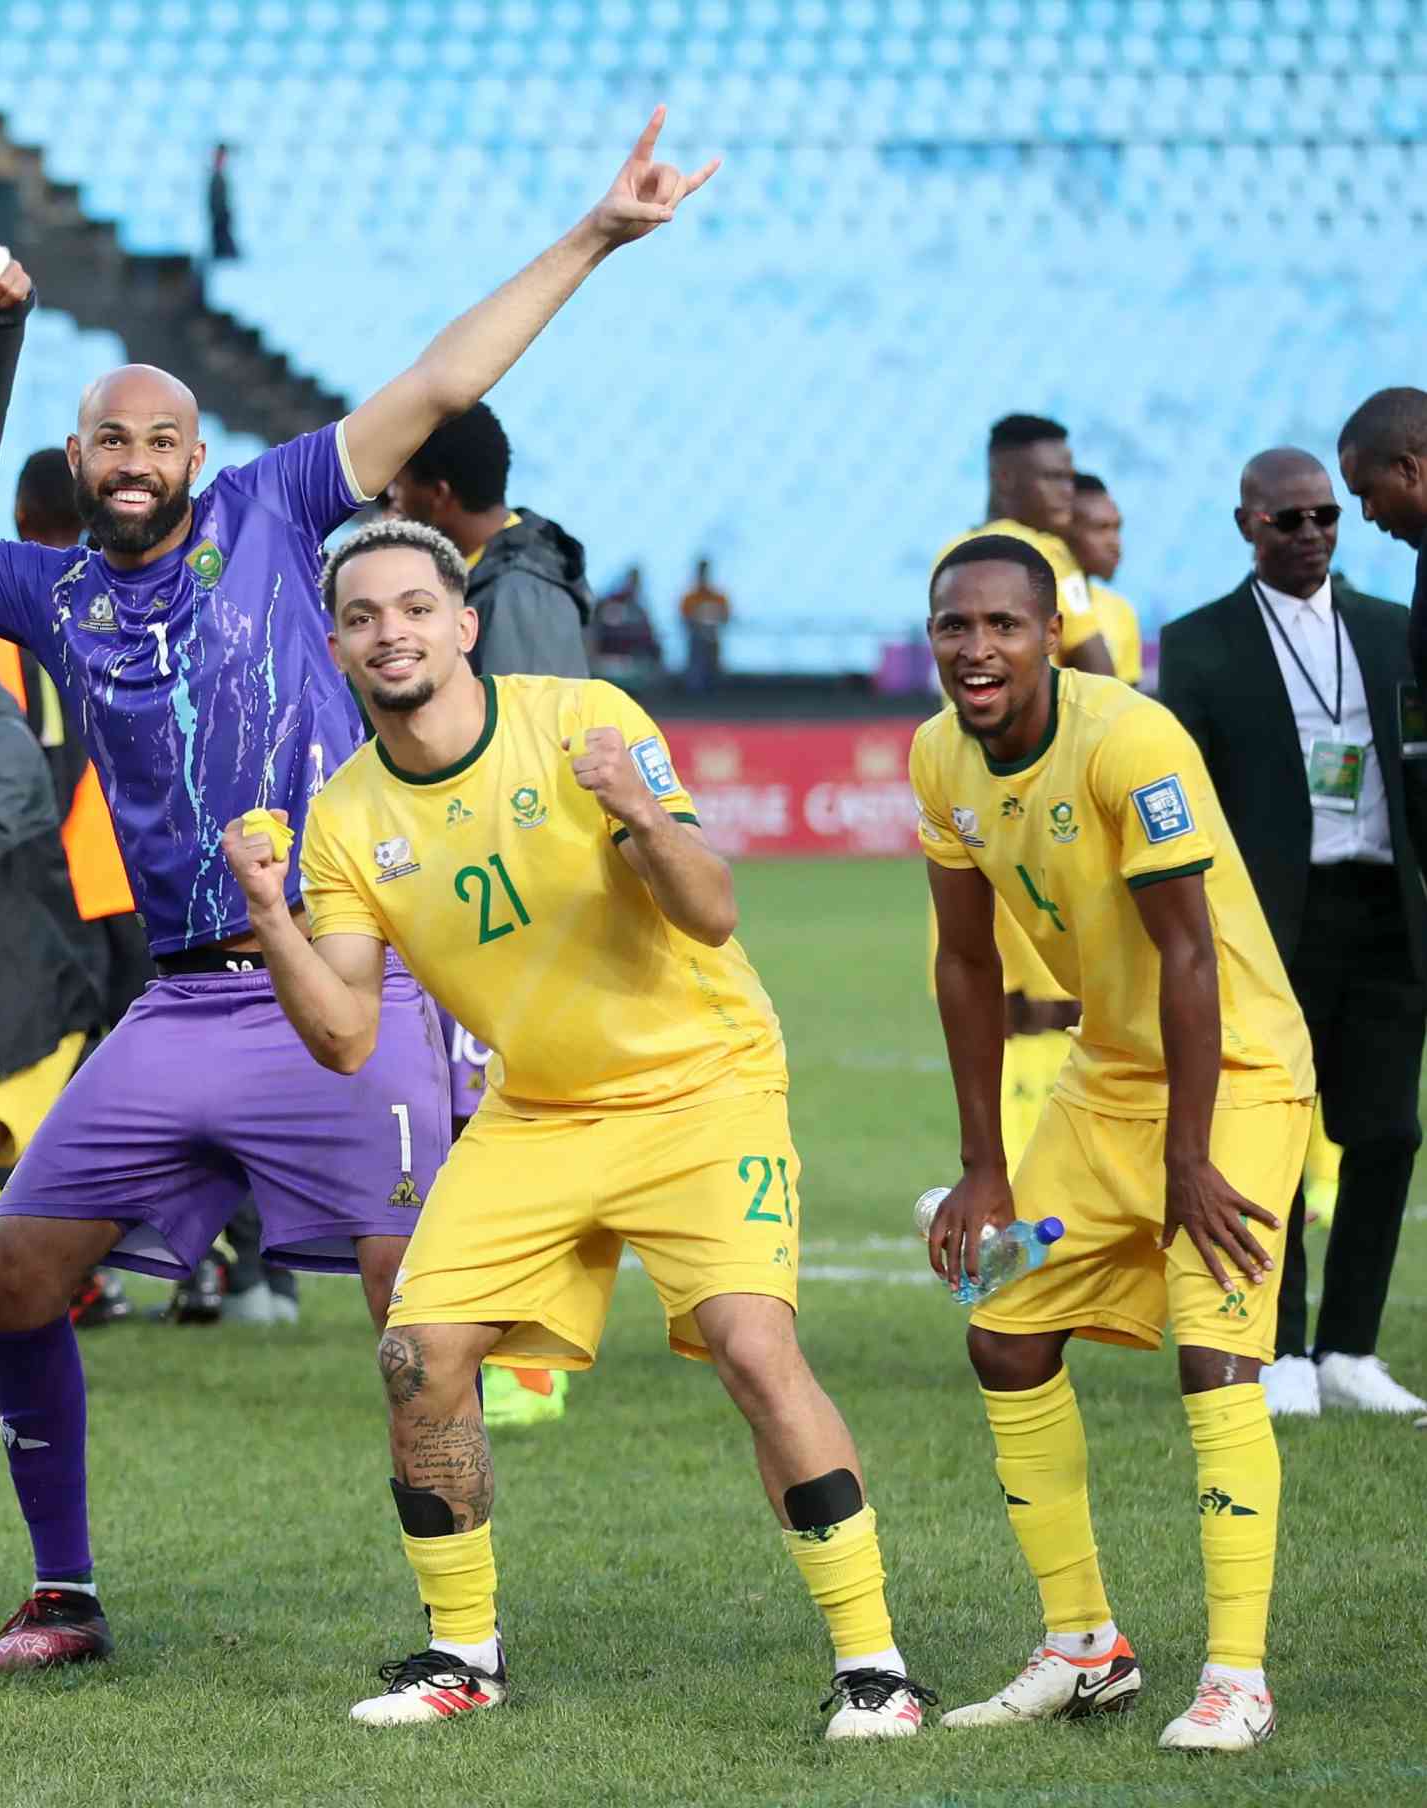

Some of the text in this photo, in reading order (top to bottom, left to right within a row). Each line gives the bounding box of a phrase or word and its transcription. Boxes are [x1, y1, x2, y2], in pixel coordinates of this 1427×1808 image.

[454, 853, 531, 944] 21
[391, 1104, 411, 1172] 1
[737, 1154, 794, 1227] 21
